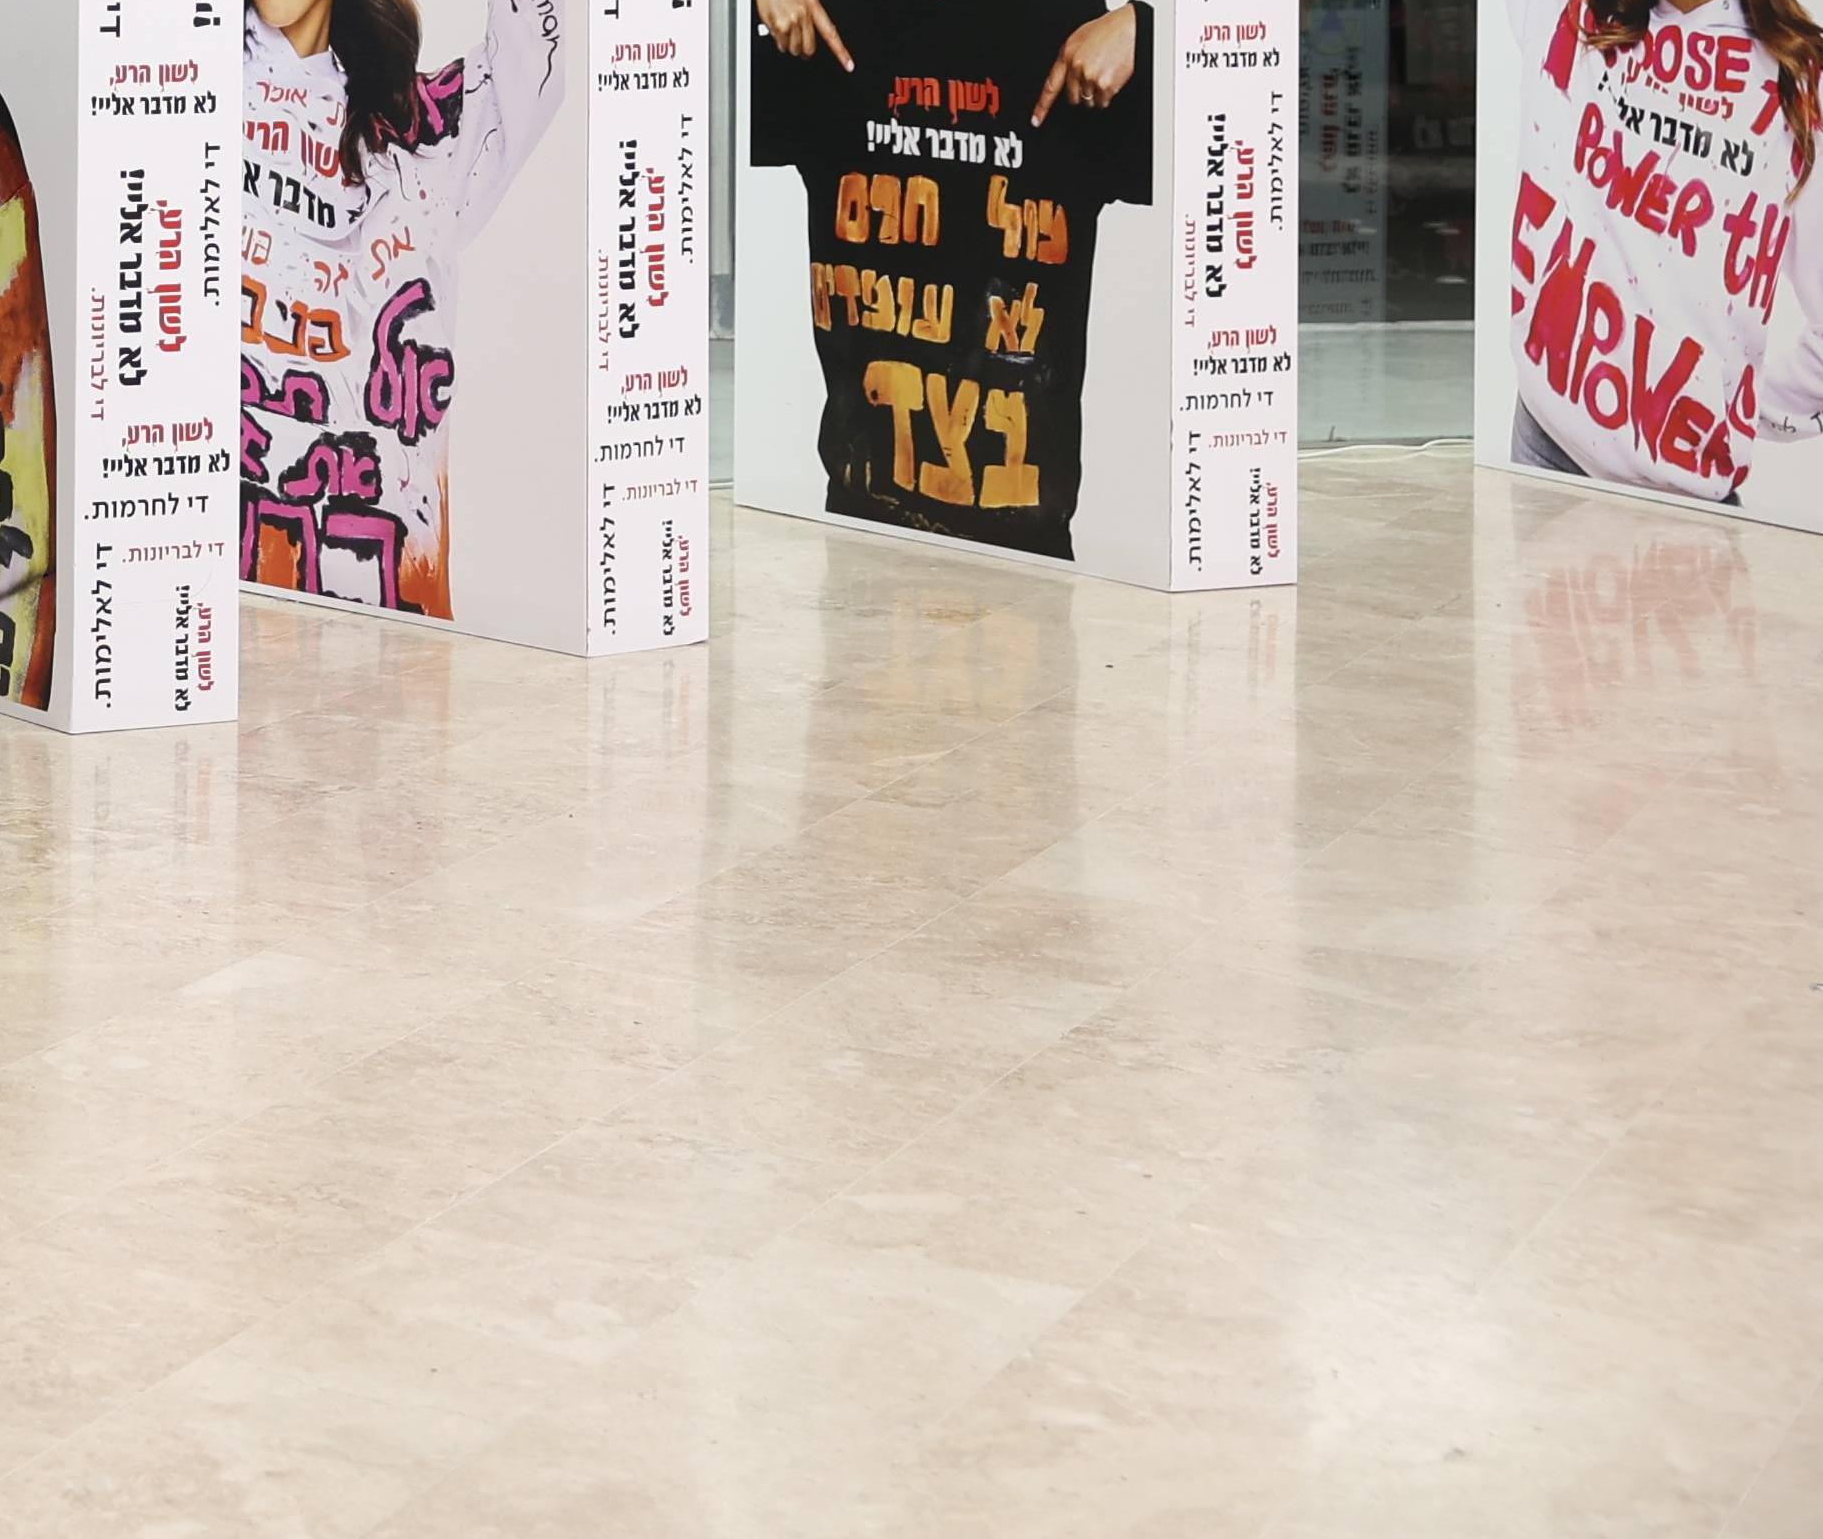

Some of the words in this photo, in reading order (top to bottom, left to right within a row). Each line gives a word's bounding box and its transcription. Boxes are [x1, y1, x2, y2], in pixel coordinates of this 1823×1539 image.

[949, 77, 1000, 123] לשון
[926, 126, 986, 164] מדבר
[994, 131, 1023, 169] לא
[1650, 111, 1712, 157] מדבר
[1574, 102, 1714, 258] POWER
[1720, 139, 1755, 177] לא
[985, 282, 1044, 354] לא
[862, 360, 1040, 509] בצד
